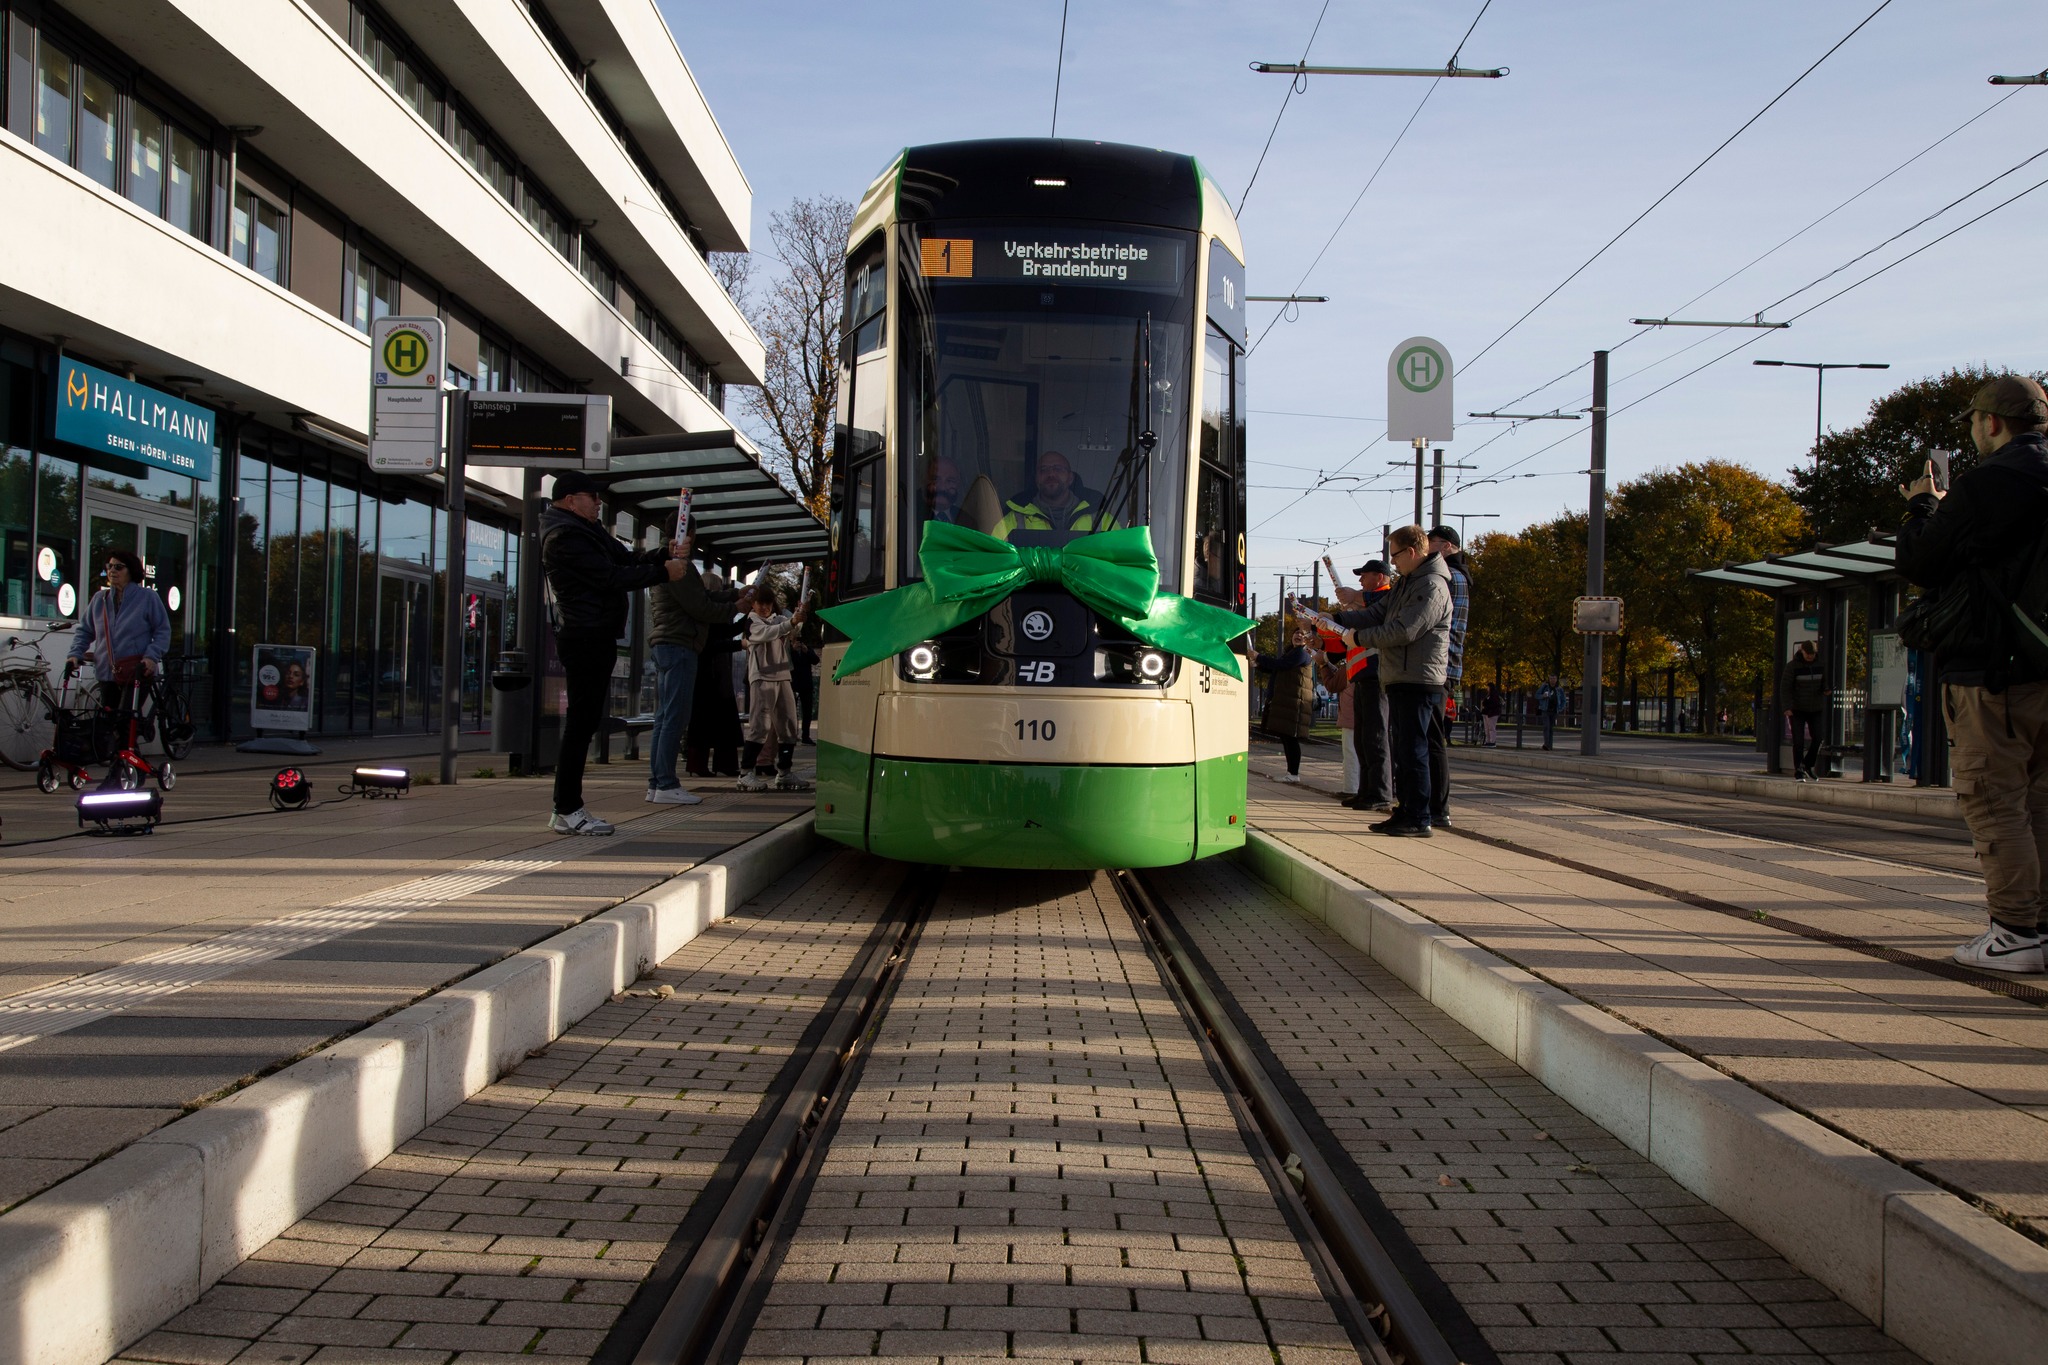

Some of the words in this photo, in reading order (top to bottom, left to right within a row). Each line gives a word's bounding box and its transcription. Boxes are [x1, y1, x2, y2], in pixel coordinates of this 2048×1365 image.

[940, 240, 951, 273] 1
[1004, 241, 1148, 261] Verkehrsbetriebe
[857, 264, 870, 298] 110
[1022, 260, 1127, 281] Brandenburg
[1222, 275, 1234, 310] 110
[395, 339, 417, 367] H
[1410, 356, 1430, 383] H
[94, 382, 209, 445] HALLMANN
[473, 402, 511, 413] Bahnsteig
[513, 403, 517, 411] 1
[107, 433, 135, 452] SEHEN
[140, 443, 167, 461] HÖREN
[171, 453, 195, 469] LEBEN
[1014, 719, 1056, 741] 110
